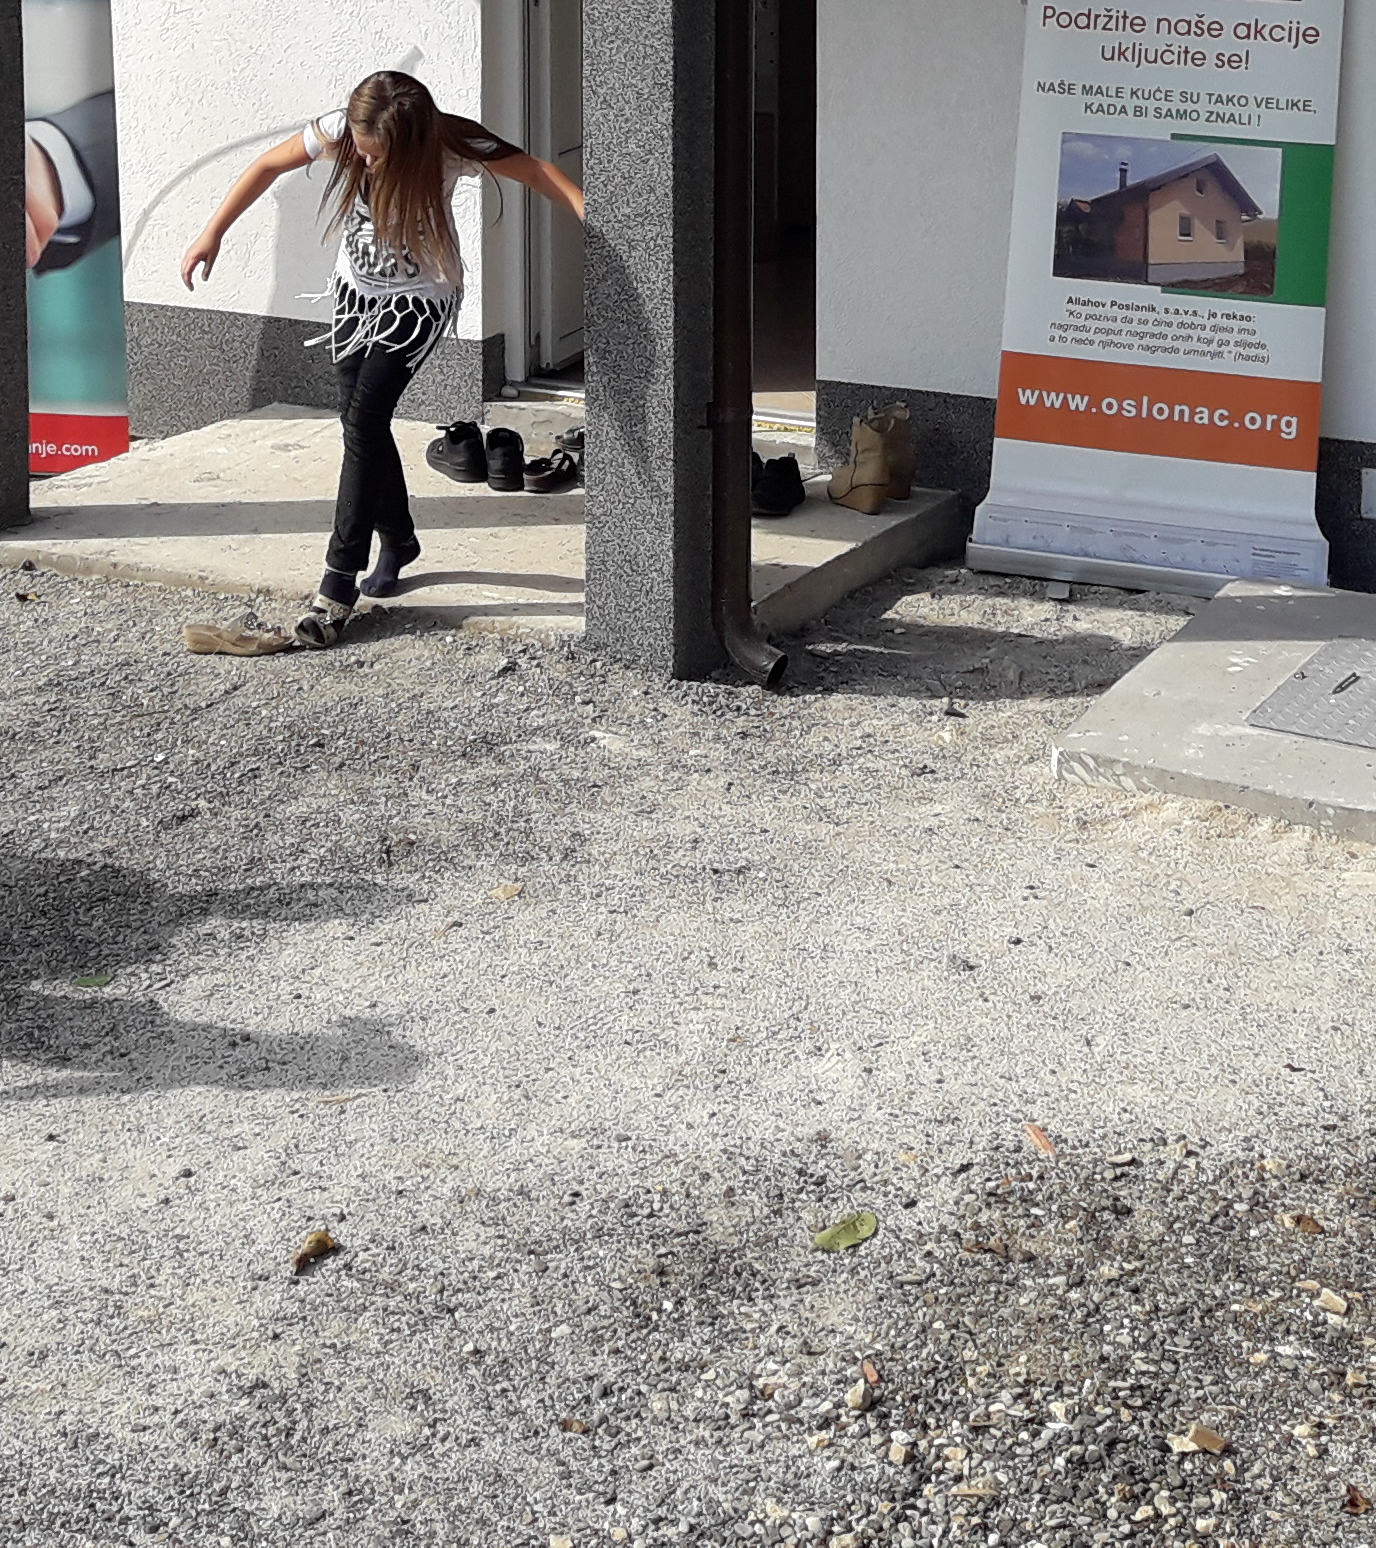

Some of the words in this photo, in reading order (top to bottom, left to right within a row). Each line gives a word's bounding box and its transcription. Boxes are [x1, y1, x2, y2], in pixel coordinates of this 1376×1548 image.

[1042, 5, 1146, 34] Podržite
[1156, 13, 1224, 39] naše
[1233, 18, 1321, 49] akcije
[1101, 42, 1206, 69] uključite
[1214, 49, 1250, 71] se!
[1036, 79, 1077, 96] NAŠE
[1081, 85, 1125, 100] MALE
[1130, 86, 1174, 103] KUĆE
[1179, 90, 1200, 104] SU
[1206, 92, 1249, 108] TAKO
[1253, 96, 1318, 115] VELIKE,
[1084, 102, 1129, 117] KADA
[1132, 104, 1148, 119] BI
[1153, 106, 1200, 122] SAMO
[1205, 110, 1252, 127] ZNALI
[1066, 295, 1106, 308] Allahov
[1110, 299, 1160, 315] Poslanik,
[1221, 311, 1256, 323] rekao:
[1050, 321, 1091, 333] nagradu
[1093, 325, 1123, 337] poput
[1084, 312, 1118, 323] poziva
[1120, 315, 1134, 324] da
[1176, 319, 1206, 332] dobra
[1237, 325, 1257, 336] ima
[1058, 333, 1068, 343] to
[1097, 339, 1135, 351] njihove
[1234, 352, 1270, 364] (hadis)
[1017, 387, 1299, 441] www.oslonac.org
[28, 439, 99, 458] nje.com
